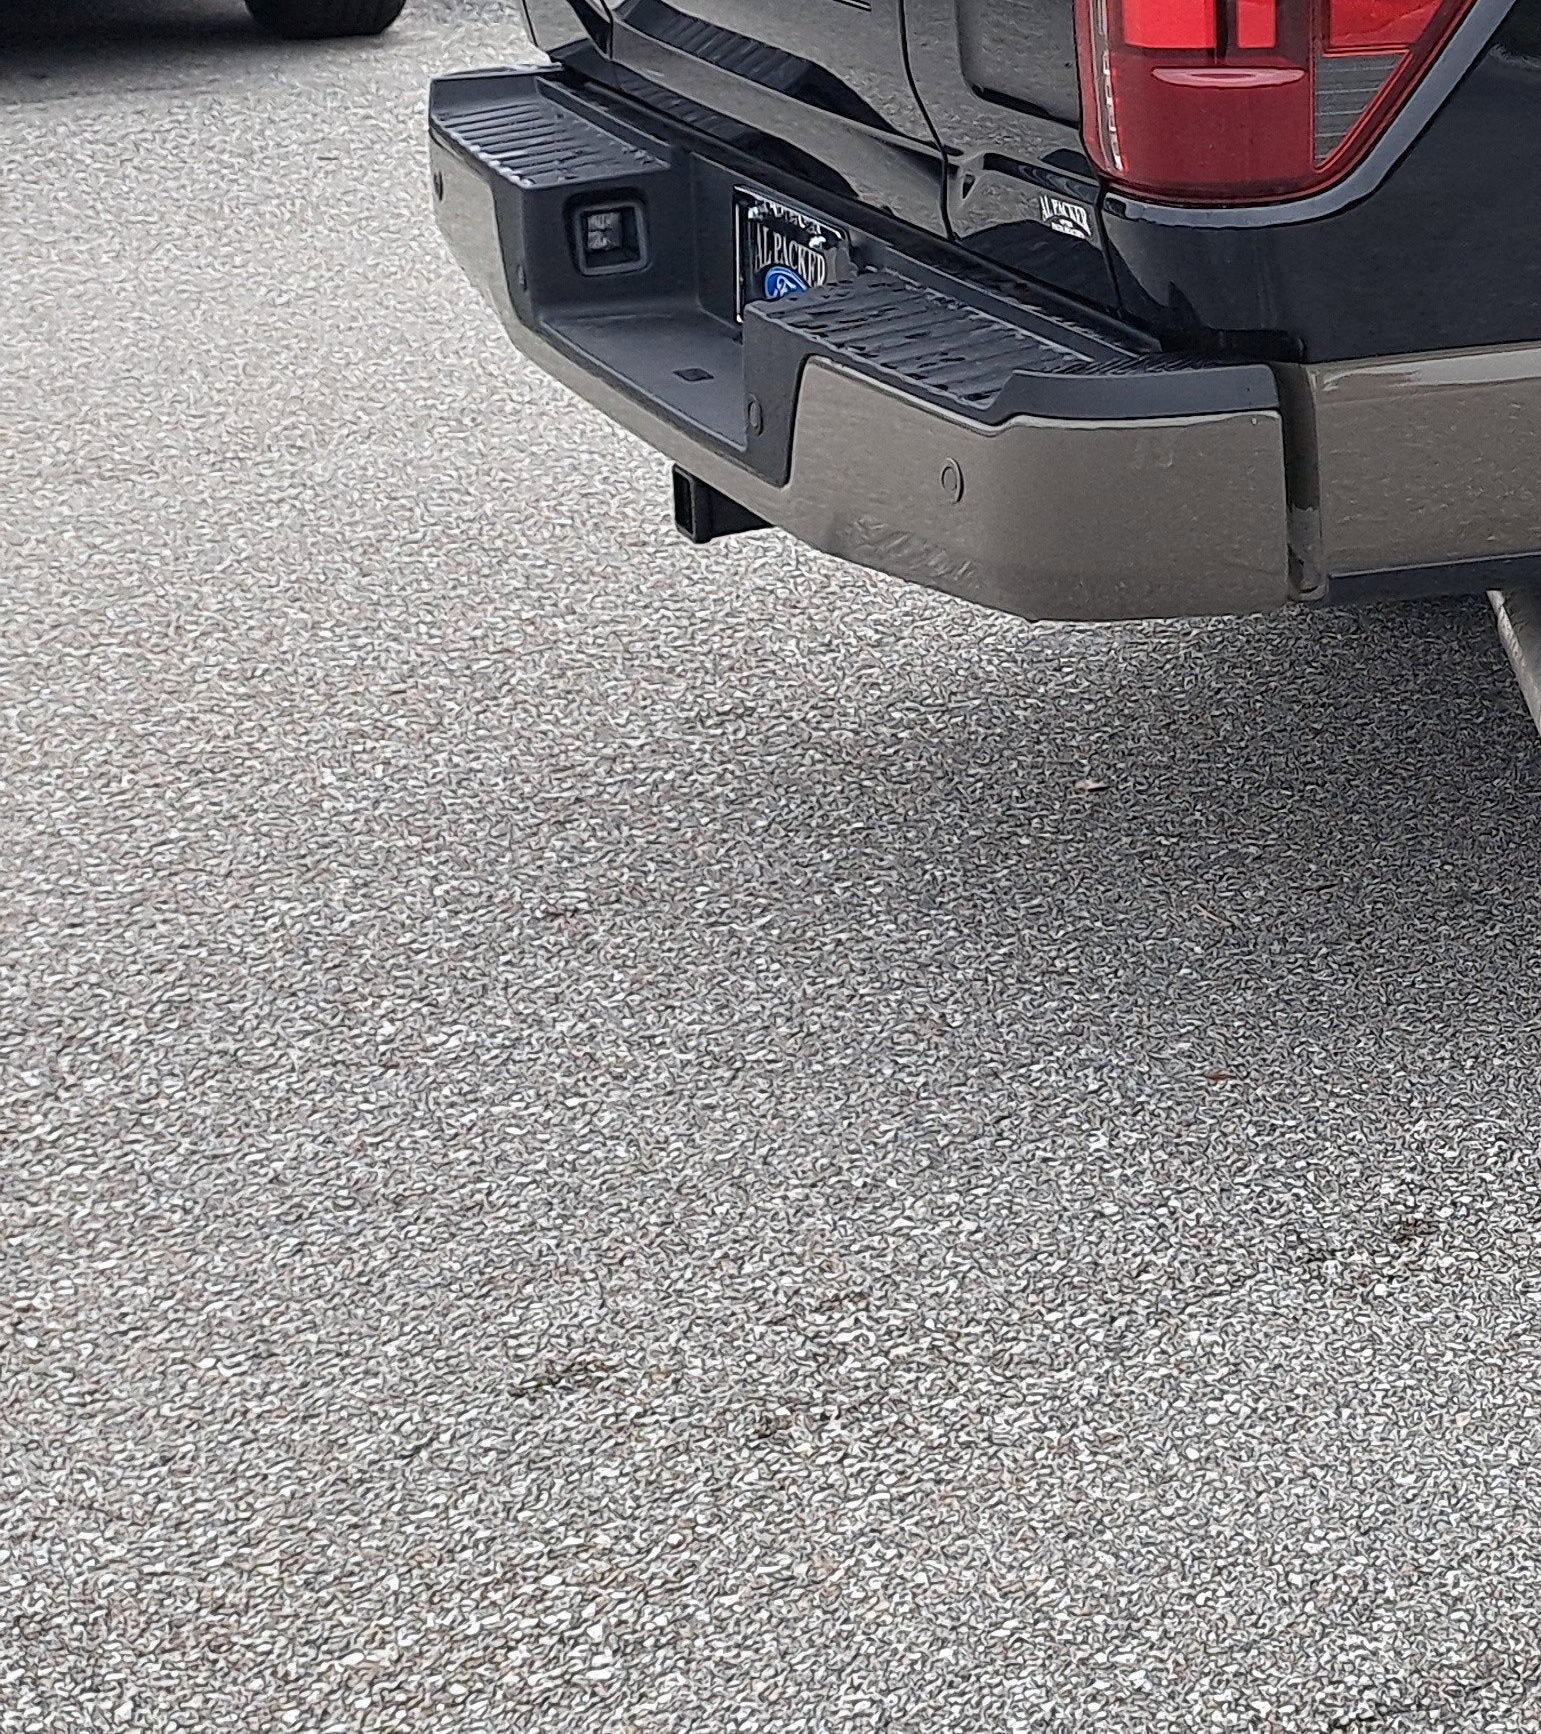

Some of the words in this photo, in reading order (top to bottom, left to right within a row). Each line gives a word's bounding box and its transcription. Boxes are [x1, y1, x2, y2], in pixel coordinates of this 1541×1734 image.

[1039, 195, 1054, 222] AL
[1051, 197, 1092, 237] PACKER
[754, 221, 772, 274] AL
